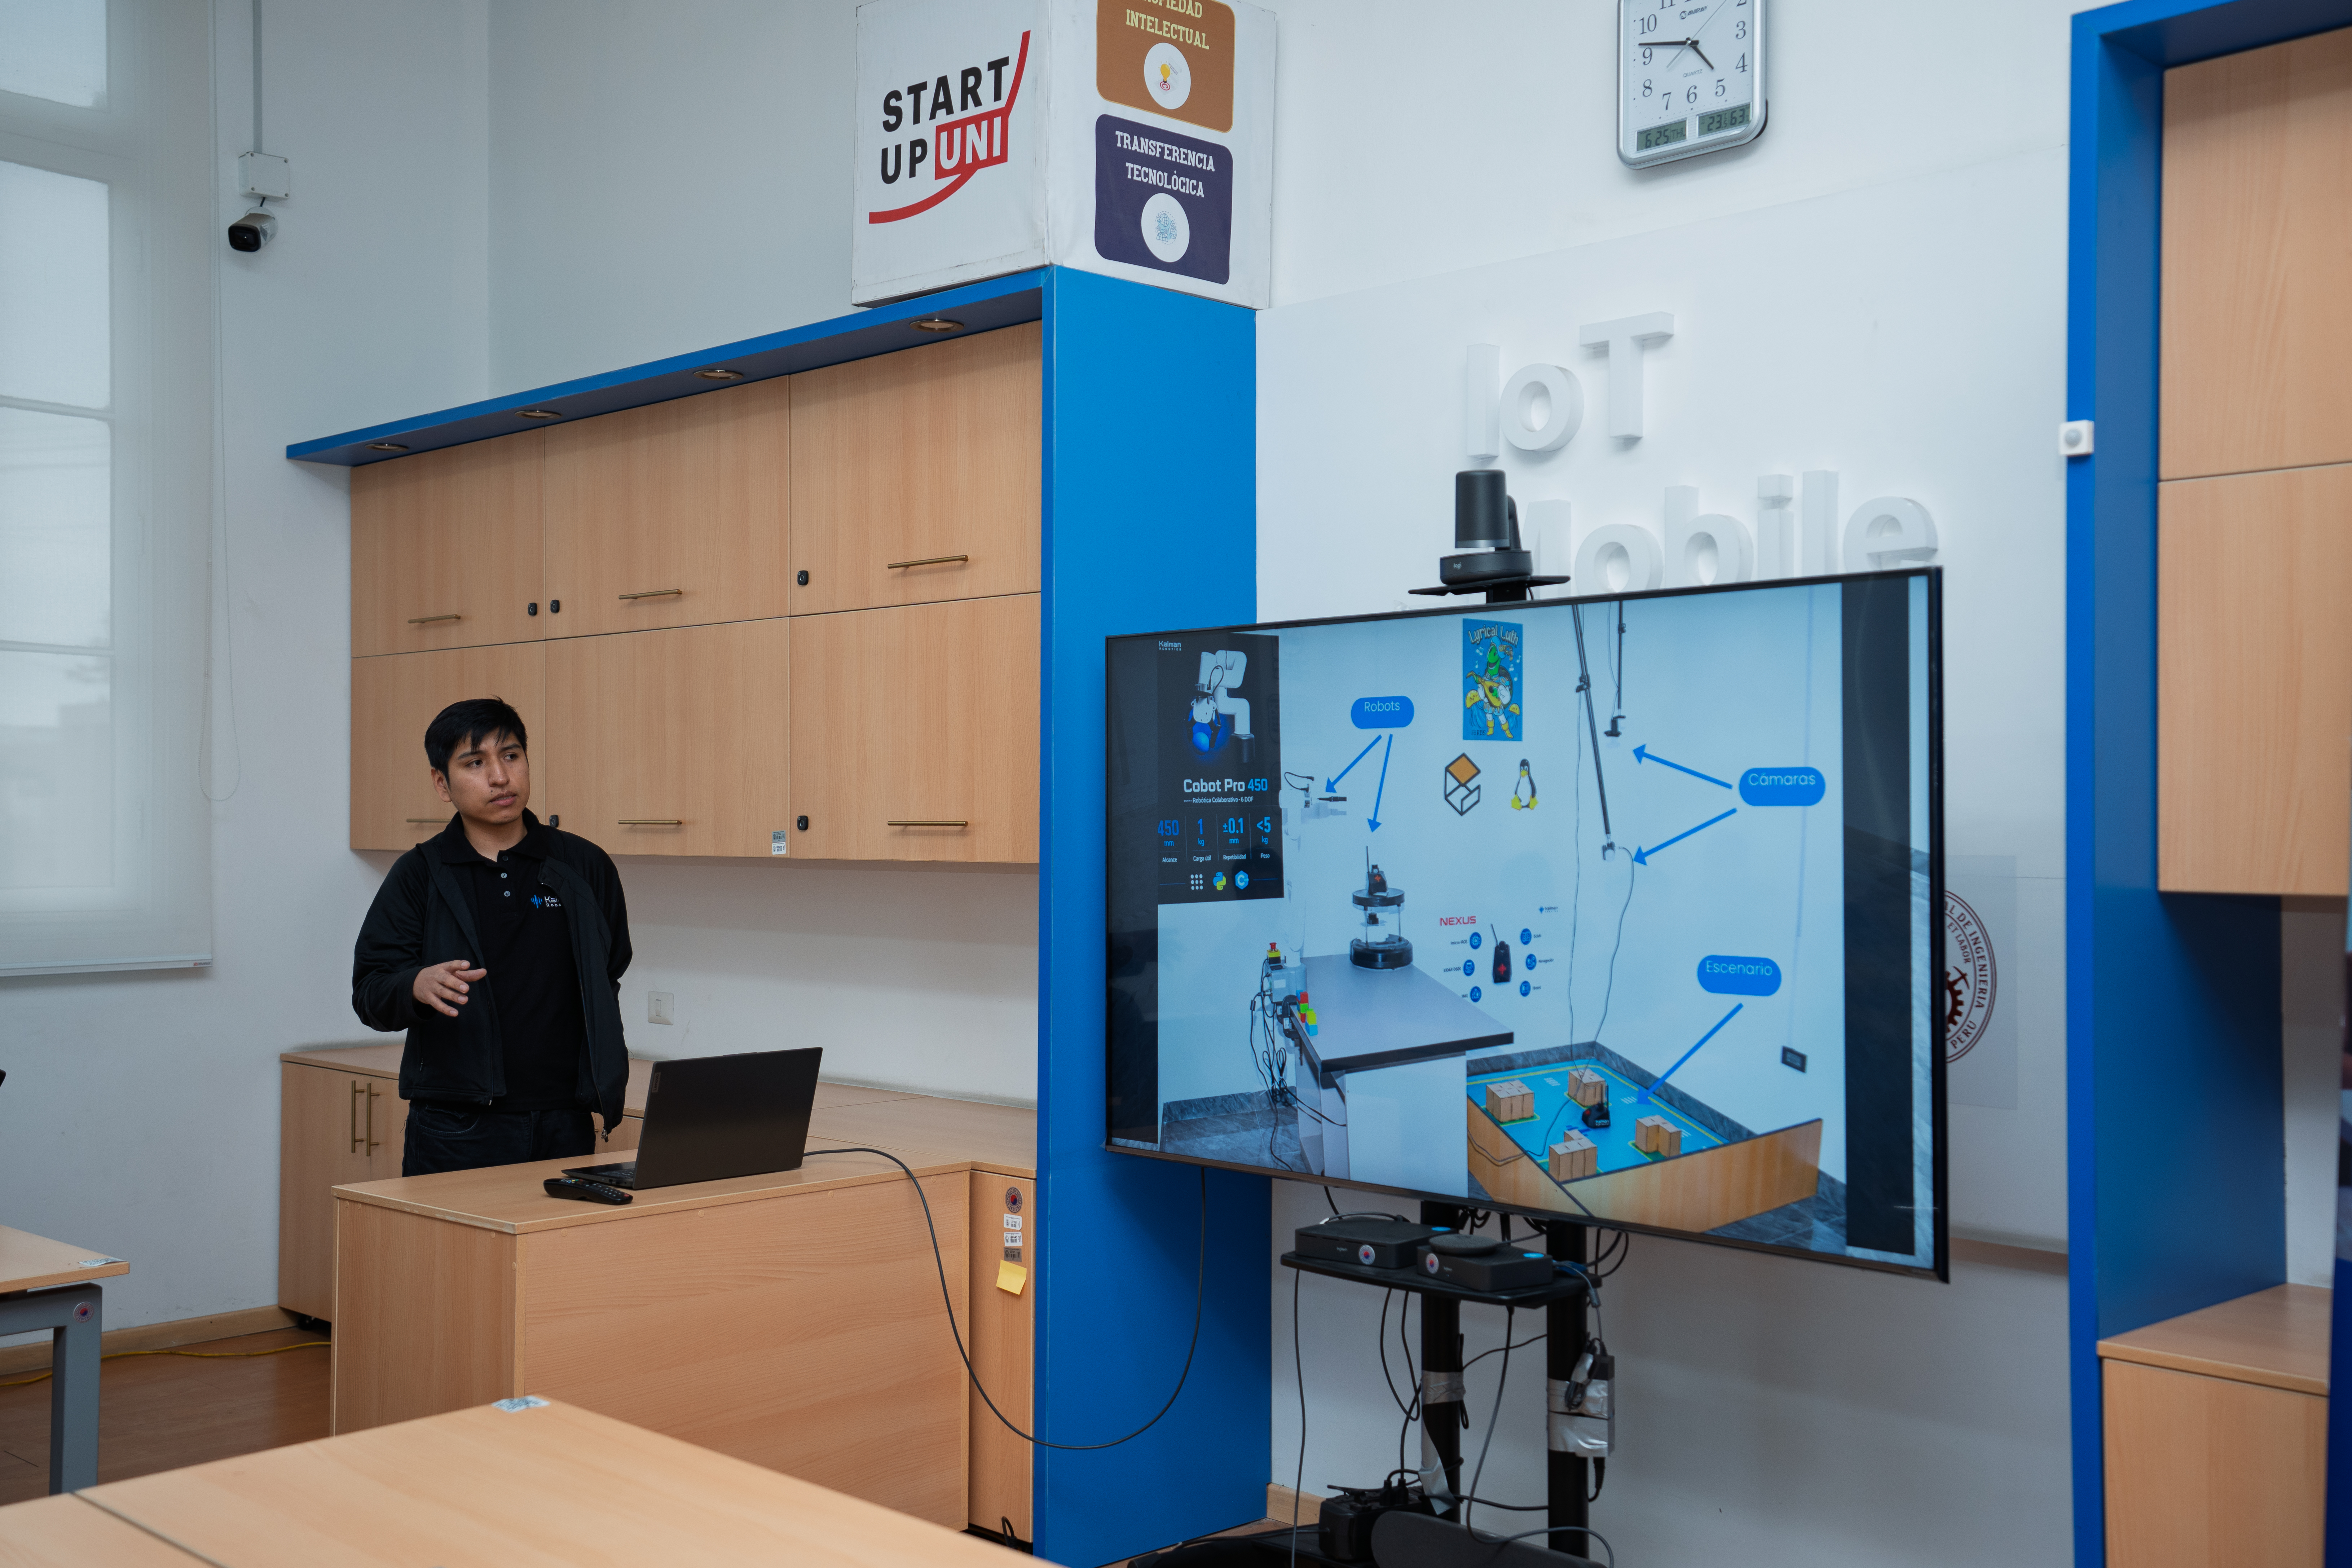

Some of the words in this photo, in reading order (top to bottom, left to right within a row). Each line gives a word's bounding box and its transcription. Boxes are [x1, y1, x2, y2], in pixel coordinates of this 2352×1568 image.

[1144, 0, 1202, 18] IEDAD
[1126, 9, 1209, 50] INTELECTUAL
[1639, 14, 1657, 35] 10
[1736, 20, 1747, 39] 3
[1643, 47, 1653, 65] 9
[1735, 52, 1748, 73] 4
[1683, 69, 1703, 78] QUARTZ
[882, 56, 1009, 132] START
[1642, 79, 1653, 97] 8
[1687, 85, 1697, 103] 6
[1715, 78, 1726, 97] 5
[1662, 92, 1672, 110] 7
[1730, 108, 1745, 125] 63
[1645, 132, 1651, 148] 6
[1655, 128, 1669, 146] 25
[881, 138, 928, 185] UP
[940, 116, 1001, 171] UNI
[1115, 131, 1215, 172] TRANSFERENCIA
[1126, 162, 1204, 198] TECNOLÓGICA
[1467, 311, 1674, 460] IoT
[1468, 624, 1498, 644] Lyrical
[1500, 625, 1519, 647] Luth
[1364, 701, 1400, 712] Robots
[1184, 778, 1221, 793] Cobot
[1224, 778, 1245, 792] Pro
[1247, 778, 1268, 792] 450
[1748, 772, 1816, 786] Cámaras
[1158, 819, 1179, 836] 450
[1197, 818, 1203, 835] 1
[1223, 817, 1243, 834] ±0.1
[1256, 816, 1272, 833] <5
[1198, 838, 1205, 847] kg
[1261, 836, 1268, 845] kg
[1440, 916, 1477, 926] NEXUS
[1947, 922, 1959, 933] ET
[1955, 933, 1972, 964] LABOR
[1706, 960, 1773, 976] Escenario
[1956, 912, 1973, 930] DE
[1969, 930, 1988, 1008] INGENIERIA
[1950, 1020, 1977, 1049] PERU
